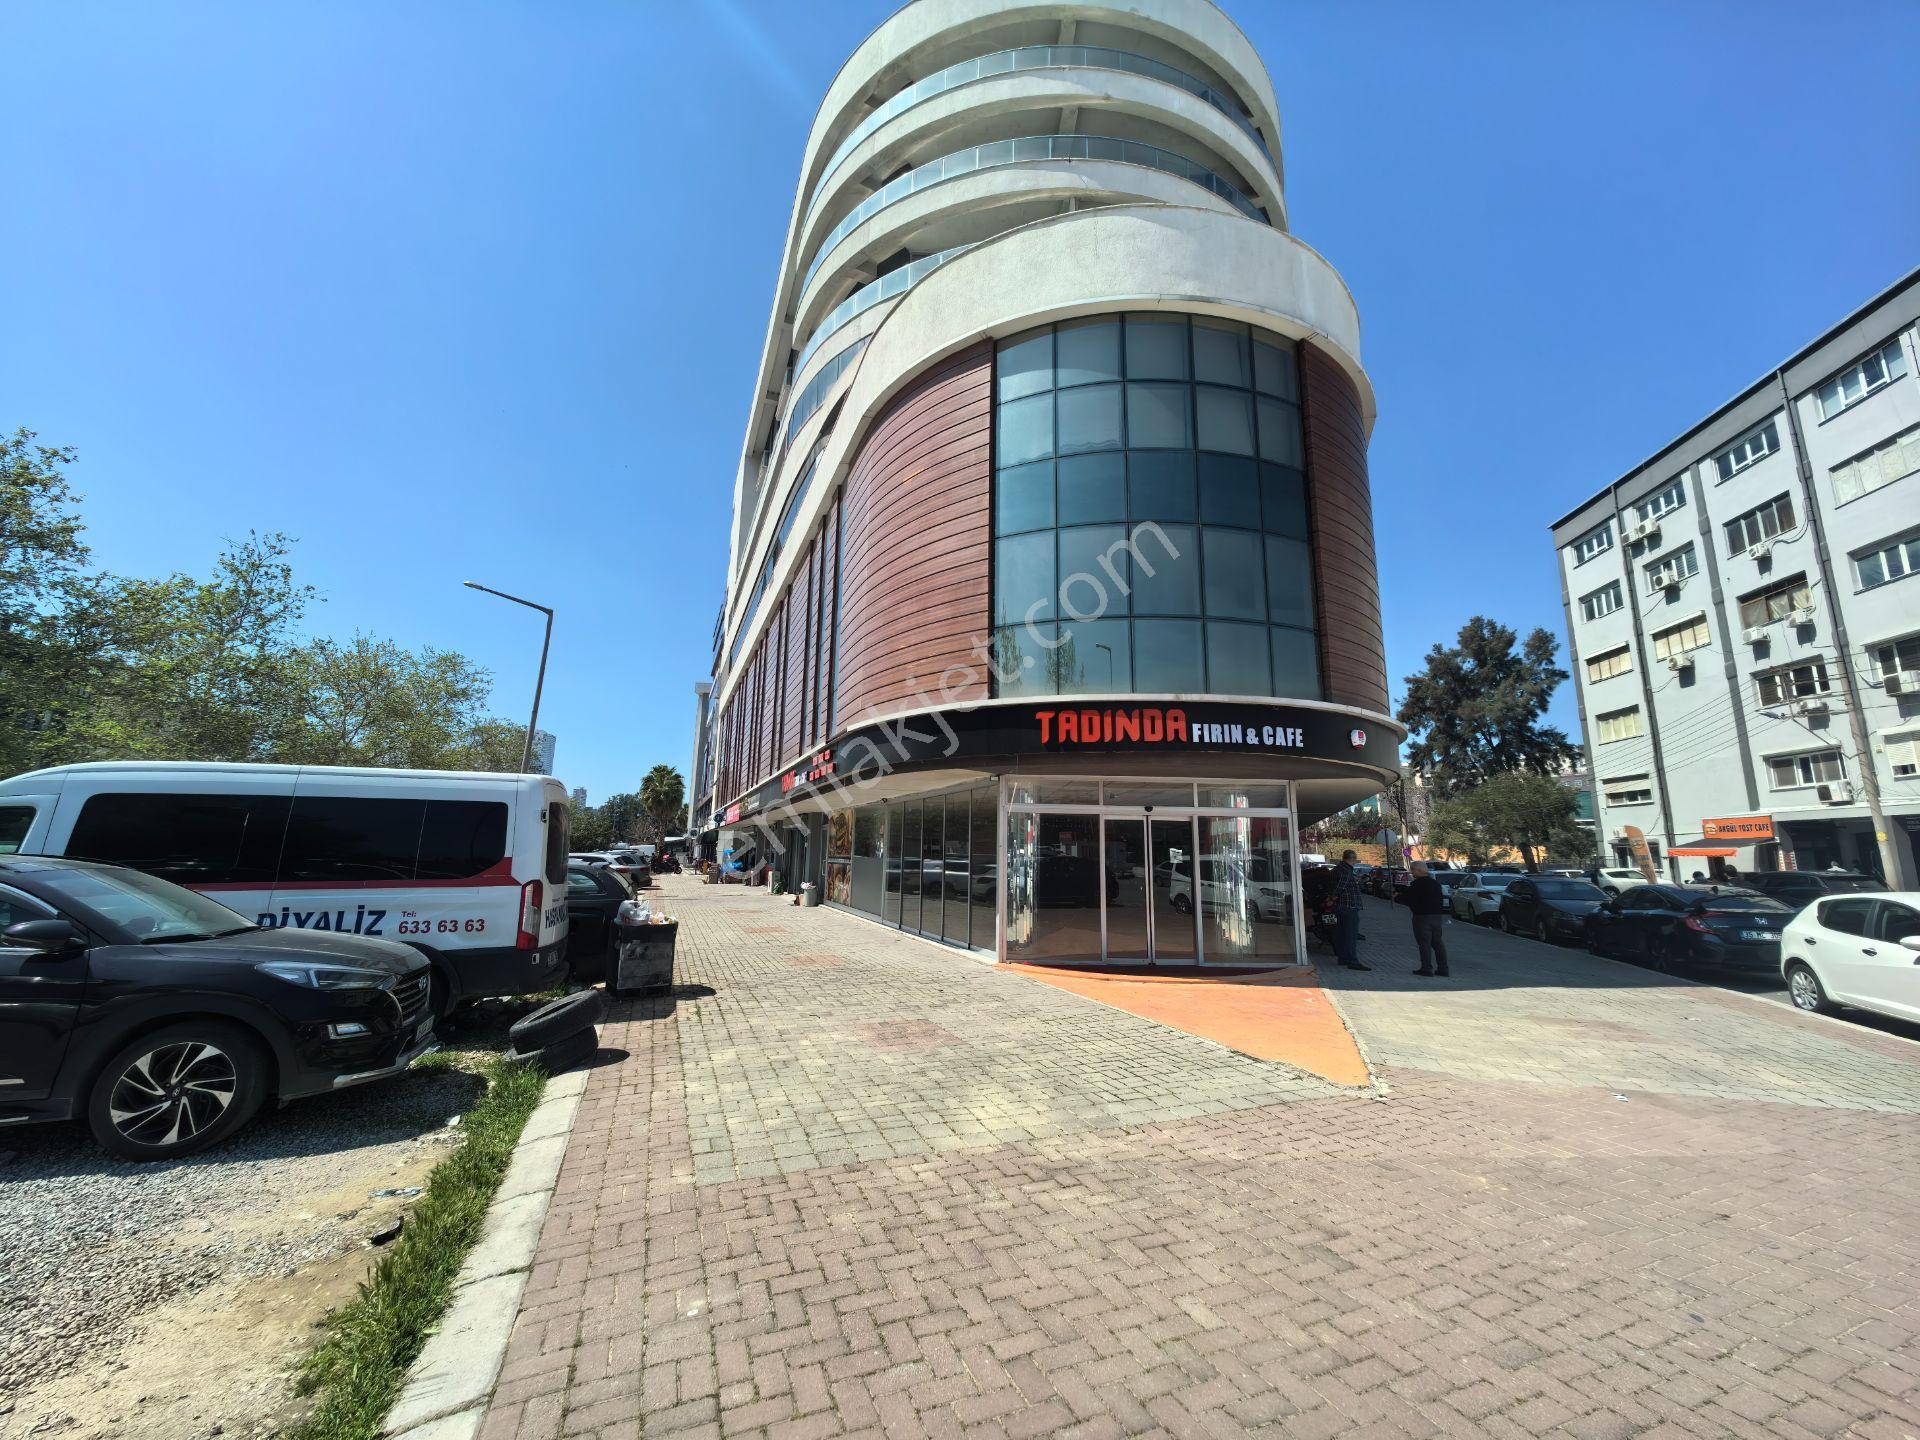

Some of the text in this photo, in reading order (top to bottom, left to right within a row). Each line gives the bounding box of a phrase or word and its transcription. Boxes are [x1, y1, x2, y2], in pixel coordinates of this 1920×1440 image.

[1036, 709, 1304, 748] TADINDA FIRIN & CAFE
[1738, 823, 1753, 833] TOST
[1755, 823, 1770, 832] CAFE
[256, 904, 387, 936] DİYALİZ
[401, 910, 417, 918] Tel:
[399, 918, 485, 935] 633 63 63
